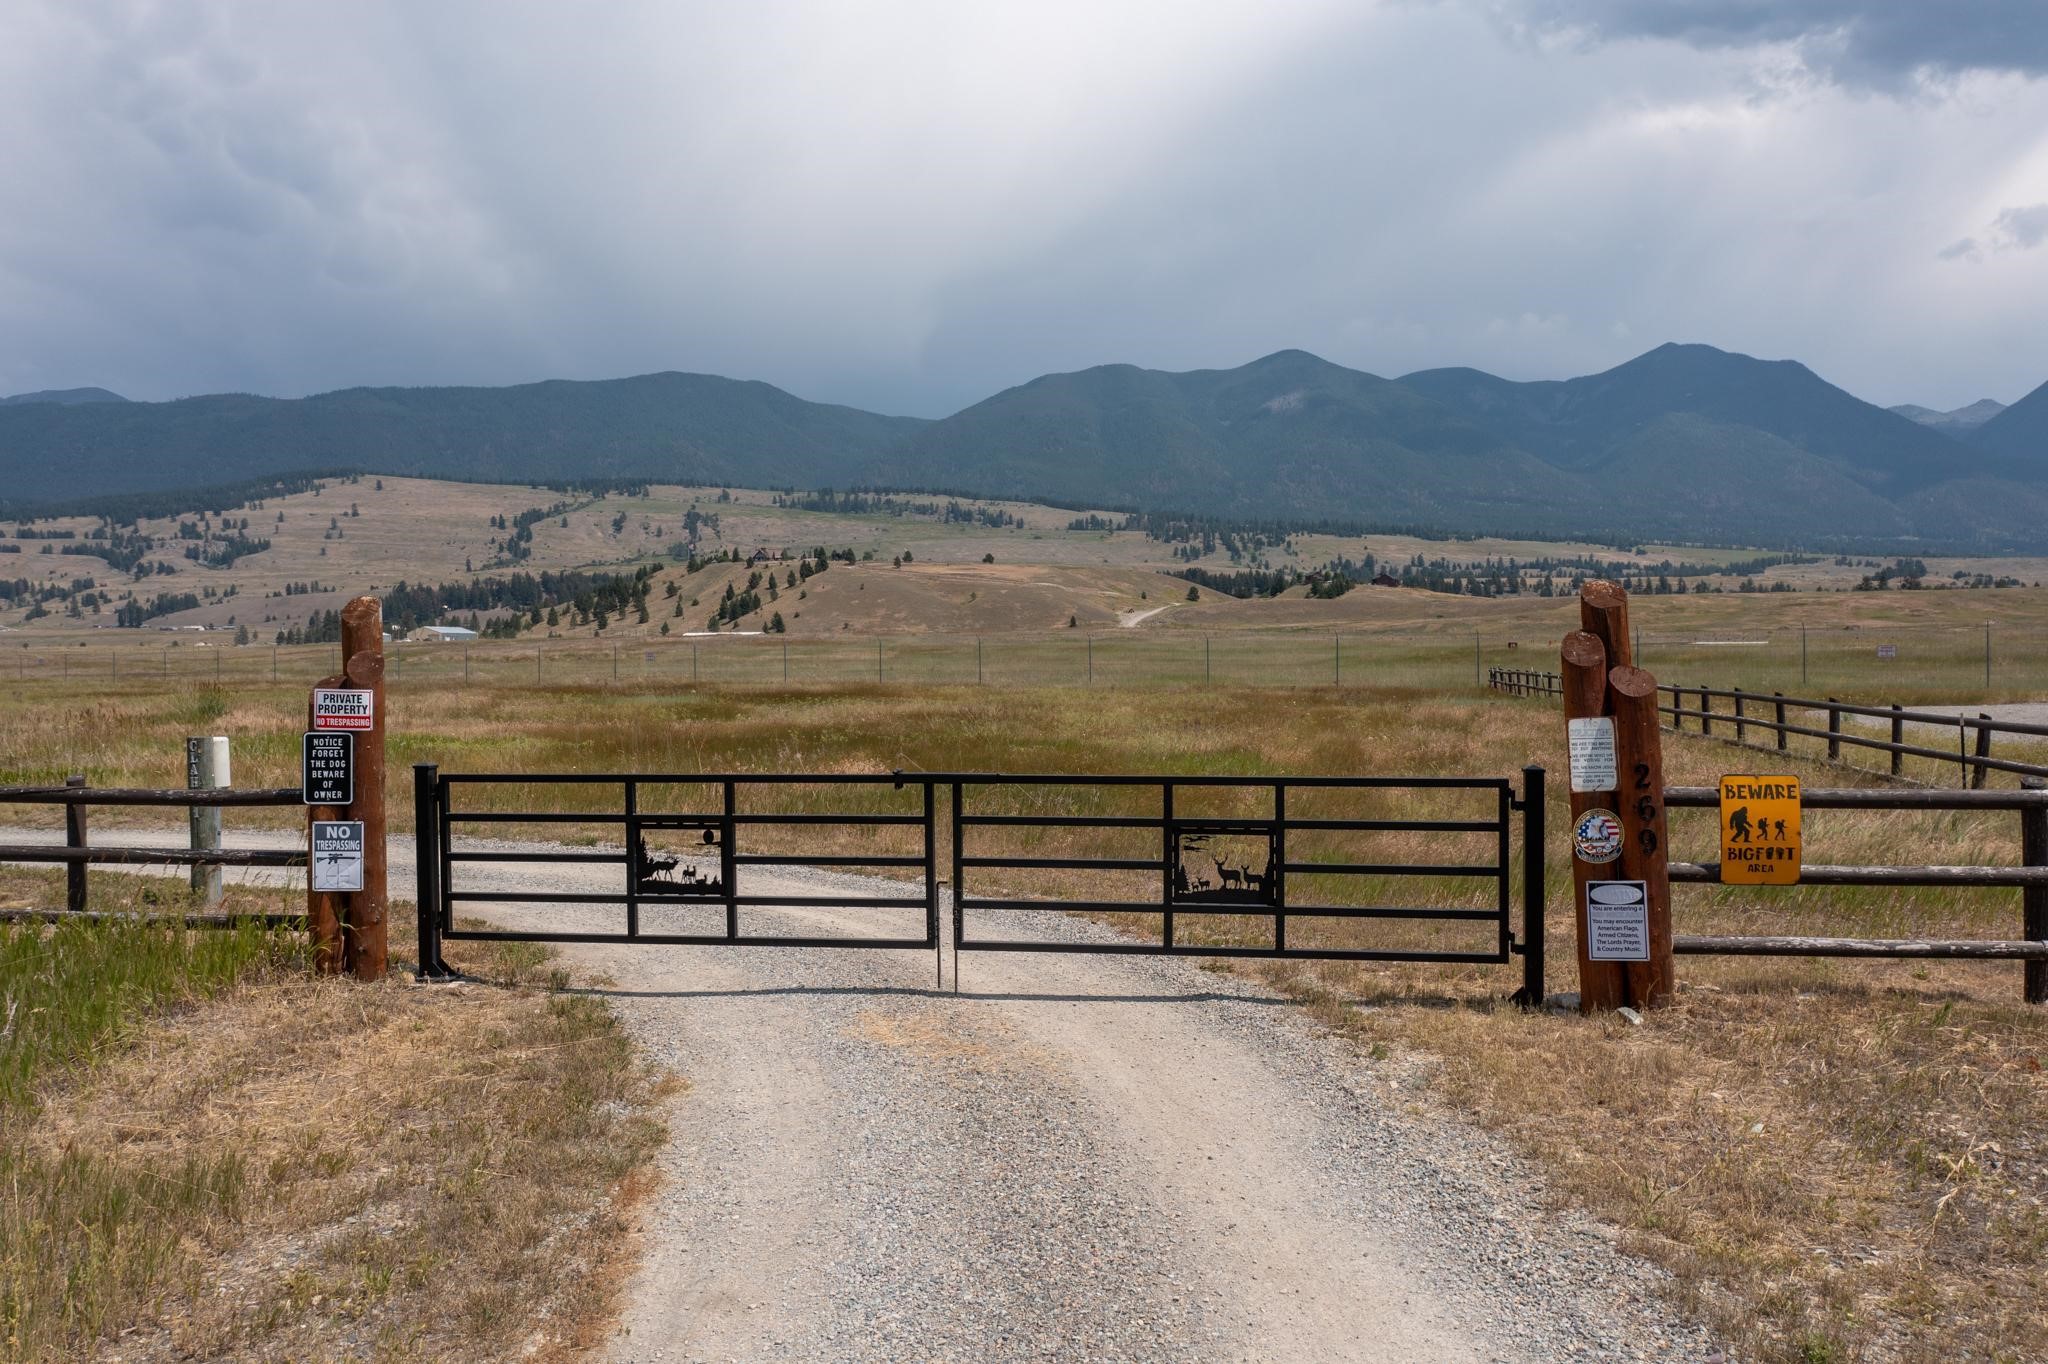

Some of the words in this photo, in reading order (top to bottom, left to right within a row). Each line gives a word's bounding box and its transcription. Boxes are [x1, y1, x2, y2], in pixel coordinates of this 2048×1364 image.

[323, 693, 362, 704] PRIVATE
[318, 704, 368, 715] PROPERTY
[316, 717, 325, 726] NO
[326, 718, 370, 727] TRESPASSING
[313, 738, 343, 746] NOTICE
[312, 749, 344, 757] FORGET
[310, 760, 326, 768] THE
[329, 760, 346, 768] DOG
[312, 770, 345, 778] BEWARE
[322, 780, 334, 788] OF
[314, 790, 342, 799] OWNER
[1725, 784, 1797, 800] BEWARE
[326, 826, 350, 839] NO
[316, 839, 360, 850] TRESPASSING
[1747, 864, 1774, 872] AREA
